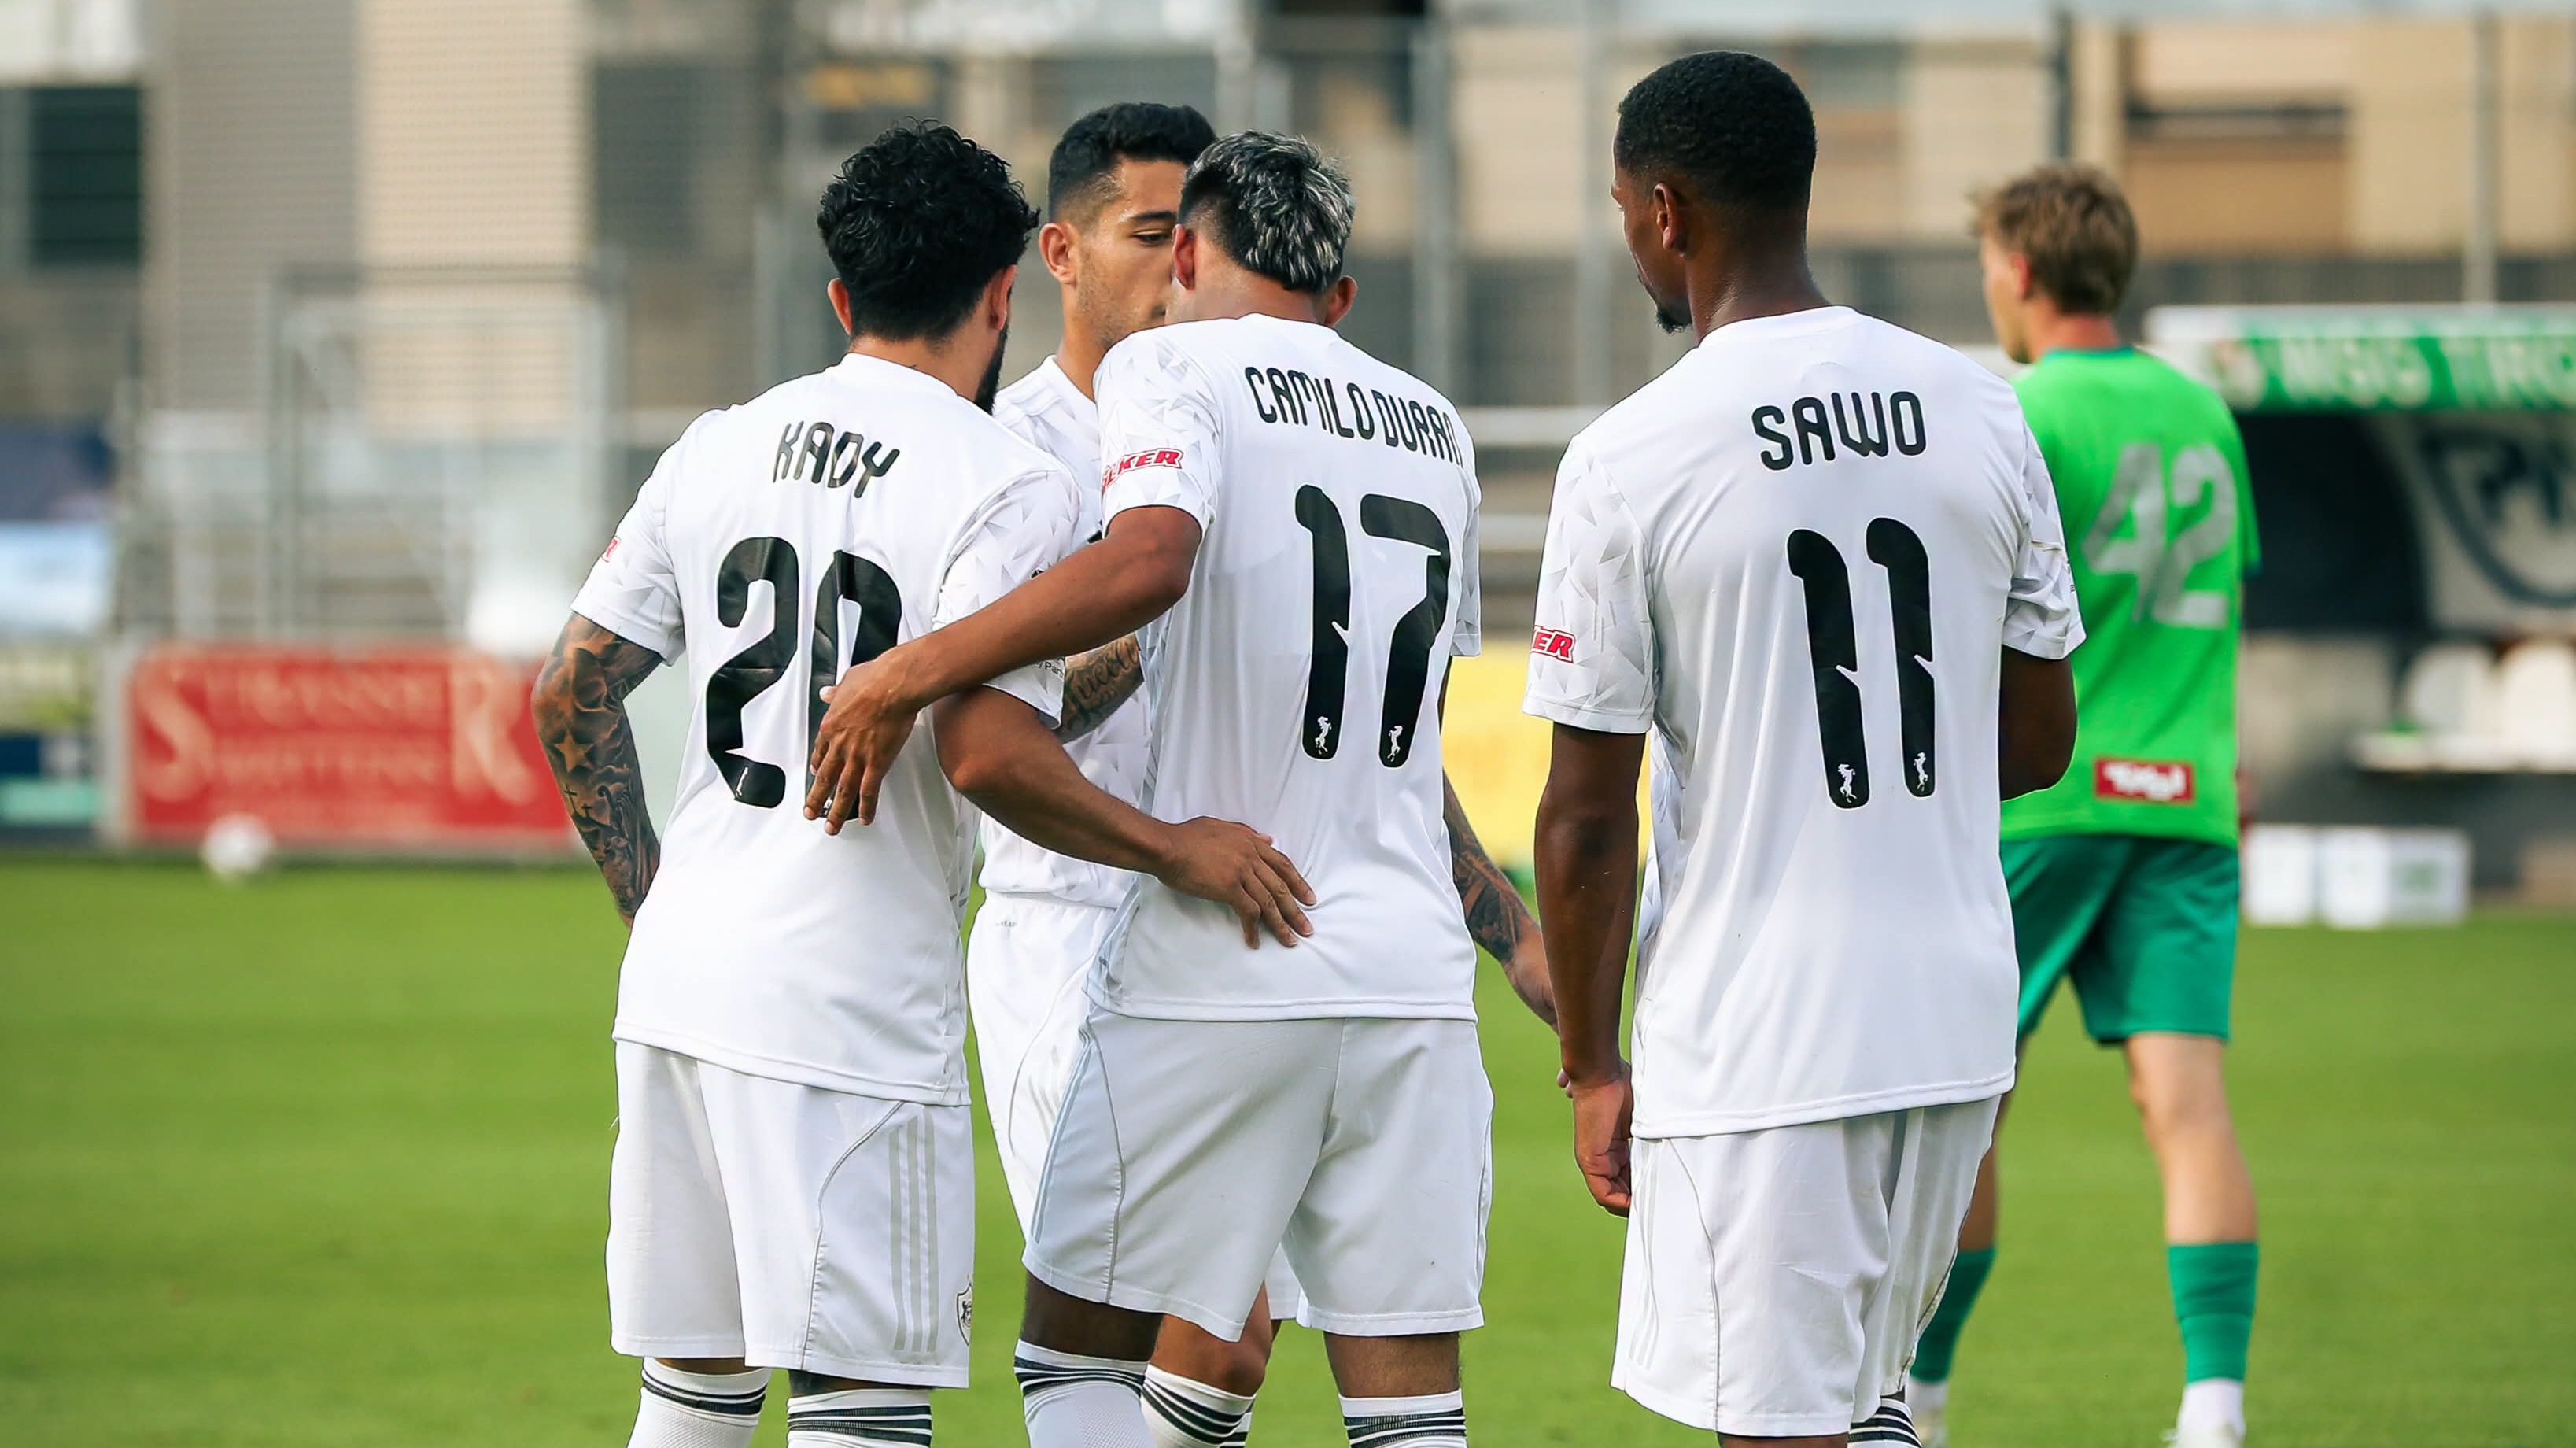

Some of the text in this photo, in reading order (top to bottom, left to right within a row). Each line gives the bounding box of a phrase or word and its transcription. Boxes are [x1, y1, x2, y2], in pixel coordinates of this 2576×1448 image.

[772, 420, 901, 499] KADY
[1244, 366, 1375, 441] CAMILO
[1751, 391, 1928, 471] SAWO
[1294, 484, 1452, 769] 17
[2080, 441, 2239, 627] 42
[707, 536, 902, 822] 20
[1787, 517, 1936, 809] 11
